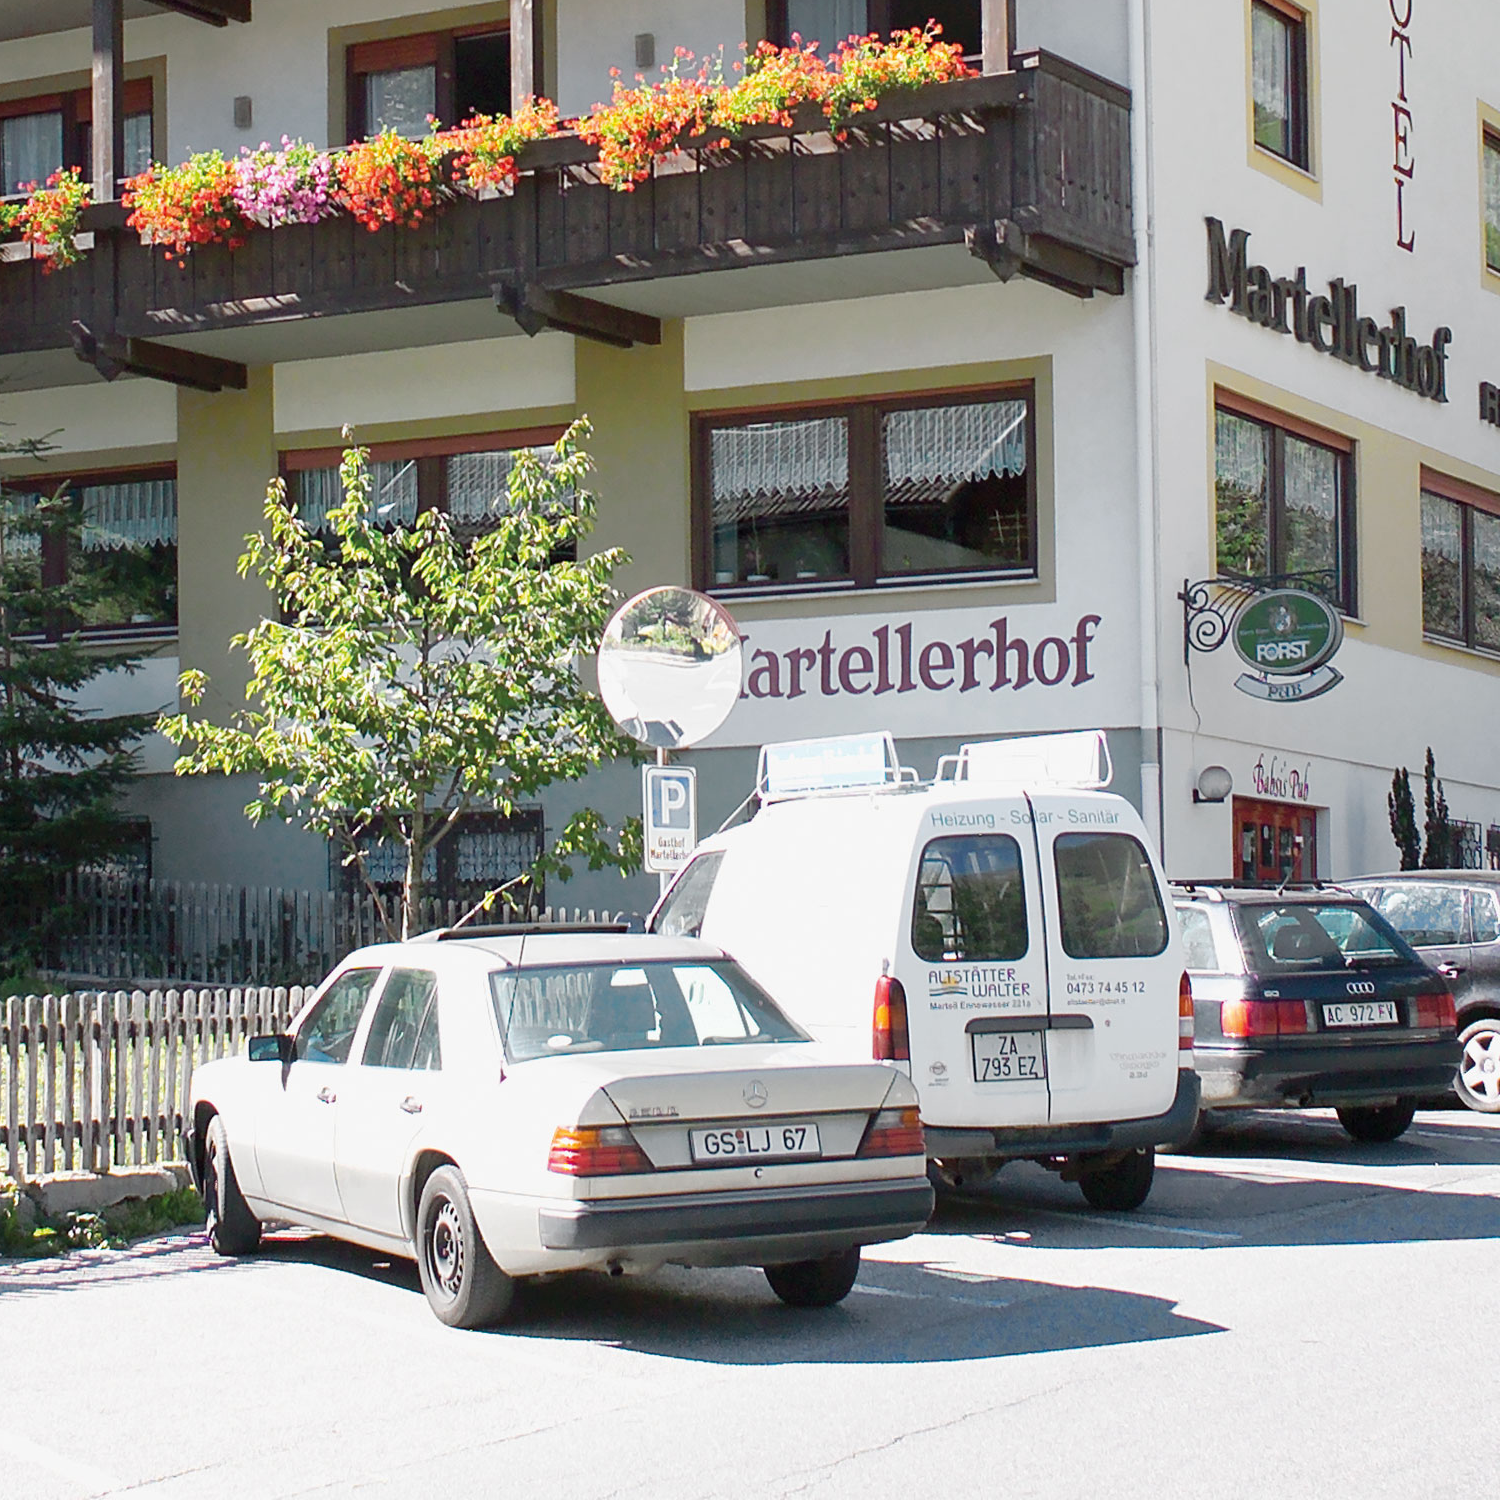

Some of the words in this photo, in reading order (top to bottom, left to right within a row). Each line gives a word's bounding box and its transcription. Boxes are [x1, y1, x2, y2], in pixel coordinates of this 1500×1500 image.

[1203, 215, 1452, 403] Martellerhof
[1256, 640, 1310, 662] FORST
[661, 779, 686, 825] P
[931, 812, 995, 827] Heizung
[1068, 809, 1120, 824] Sanitär
[929, 966, 1016, 984] ALTSTÄTTER
[972, 983, 1030, 997] WALTER
[1066, 982, 1094, 994] 0473
[1098, 982, 1111, 993] 74
[1114, 981, 1128, 993] 45
[1132, 981, 1145, 993] 12
[1349, 1005, 1375, 1021] 972
[998, 1036, 1018, 1055] ZA
[981, 1056, 1011, 1079] 793
[782, 1128, 806, 1150] 67
